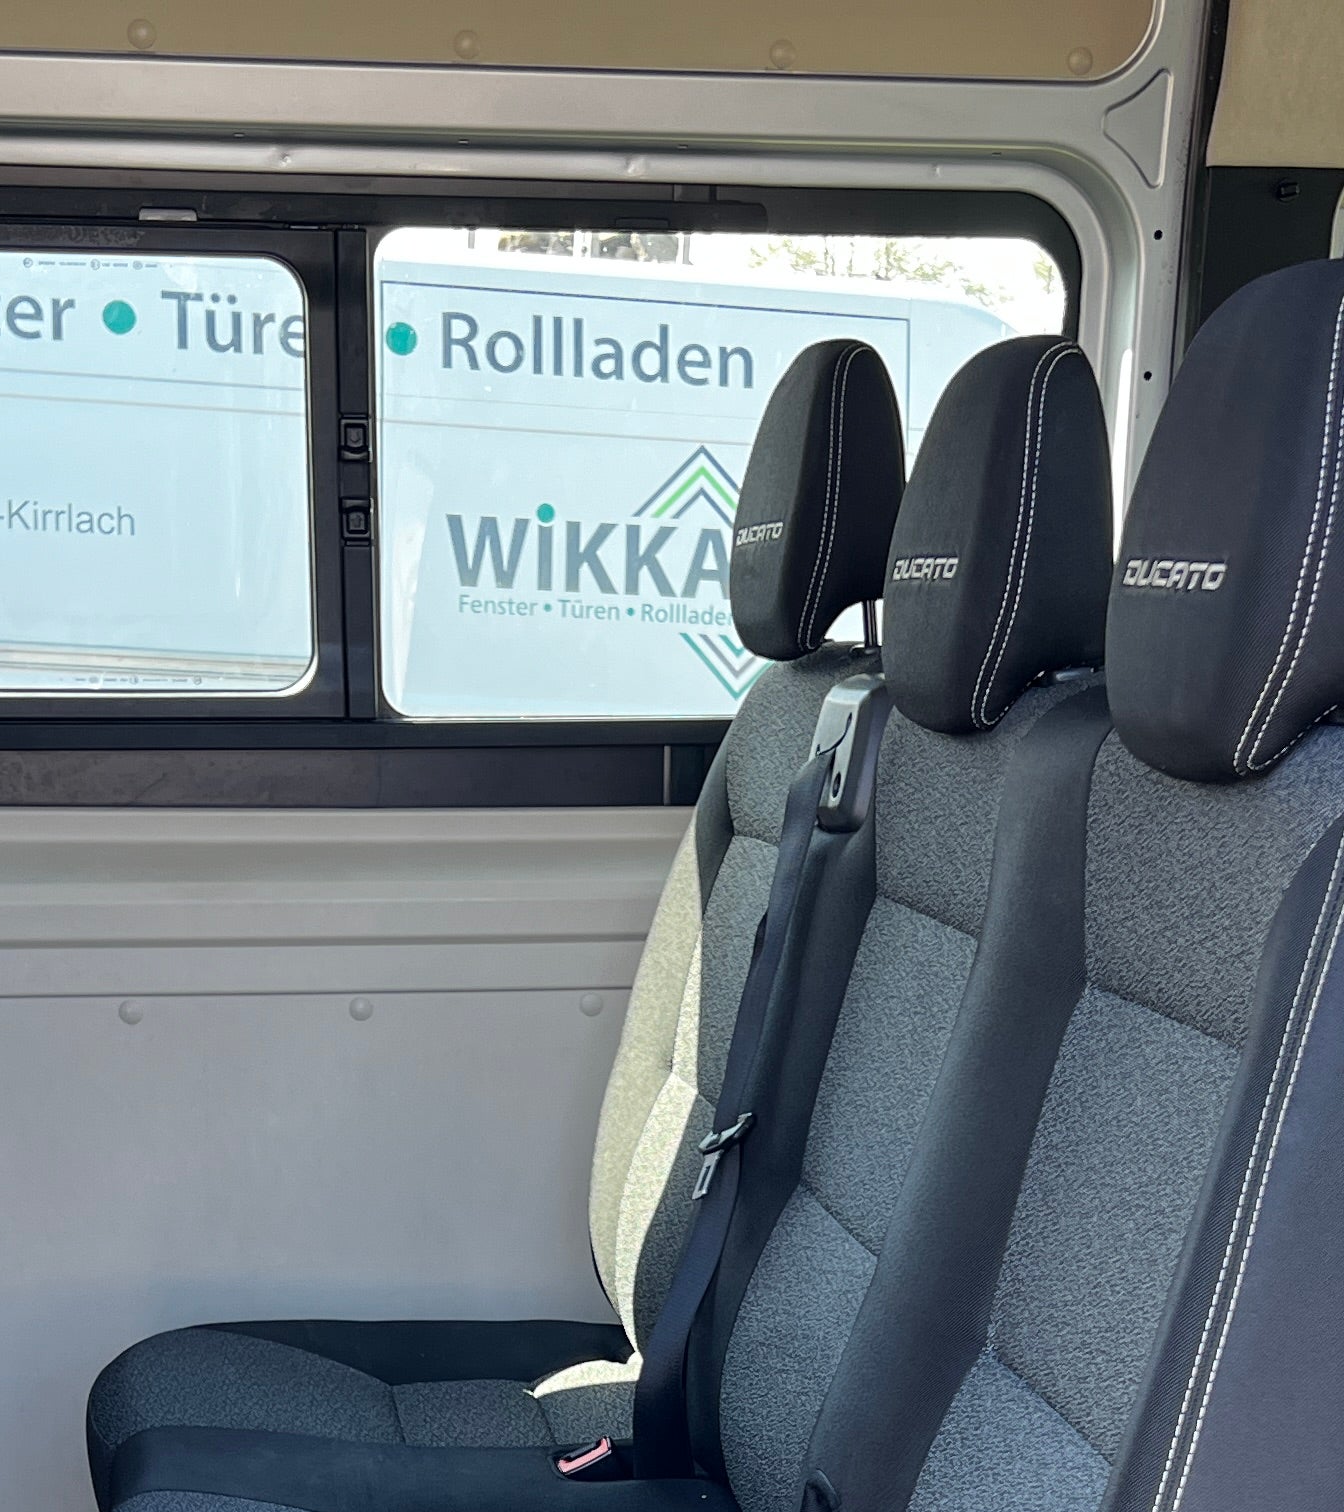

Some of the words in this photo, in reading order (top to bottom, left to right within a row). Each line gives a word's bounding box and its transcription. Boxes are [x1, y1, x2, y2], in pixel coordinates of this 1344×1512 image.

[441, 311, 754, 389] Rollladen
[736, 521, 784, 547] DUCATO
[892, 556, 959, 582] DUCATO
[1122, 558, 1228, 592] DUCATO
[458, 594, 538, 617] Fenster
[558, 598, 620, 621] Türen
